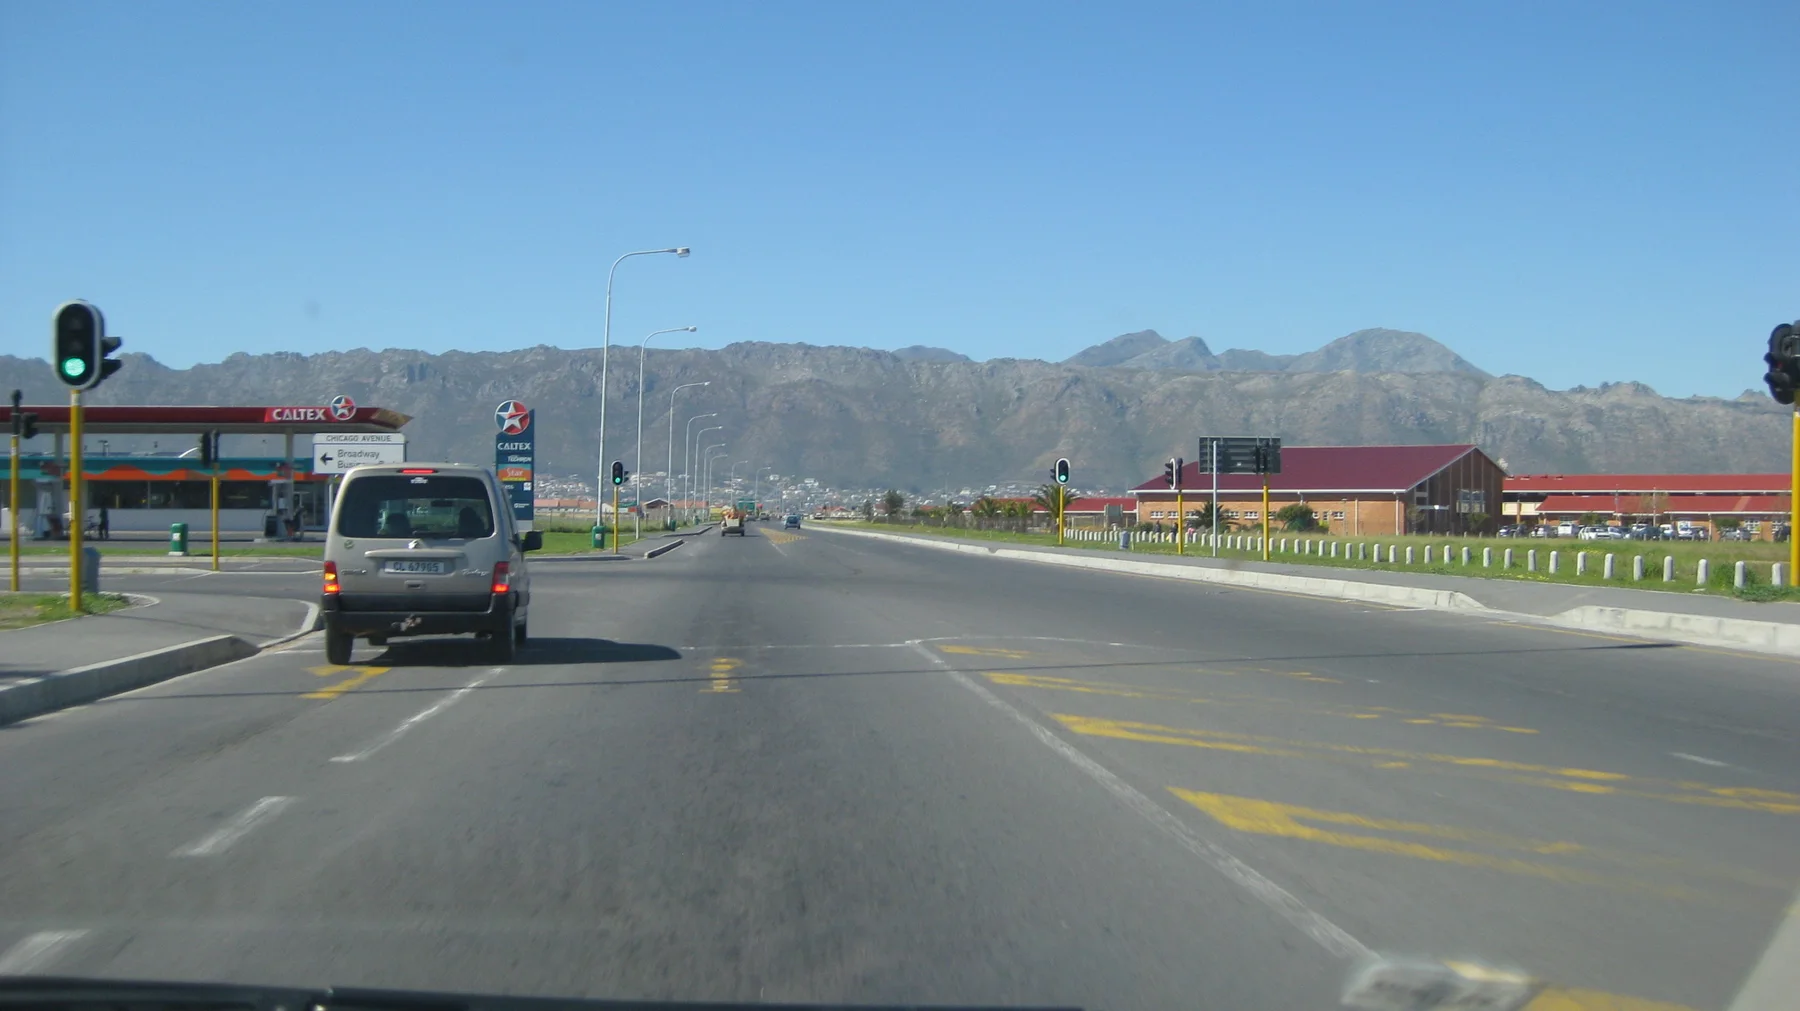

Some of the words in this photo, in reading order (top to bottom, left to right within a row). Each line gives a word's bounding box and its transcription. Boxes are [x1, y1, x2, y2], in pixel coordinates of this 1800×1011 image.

[272, 408, 327, 421] CALTEX
[497, 442, 531, 451] CALTEX
[337, 449, 380, 459] Broadway
[506, 467, 524, 478] Star
